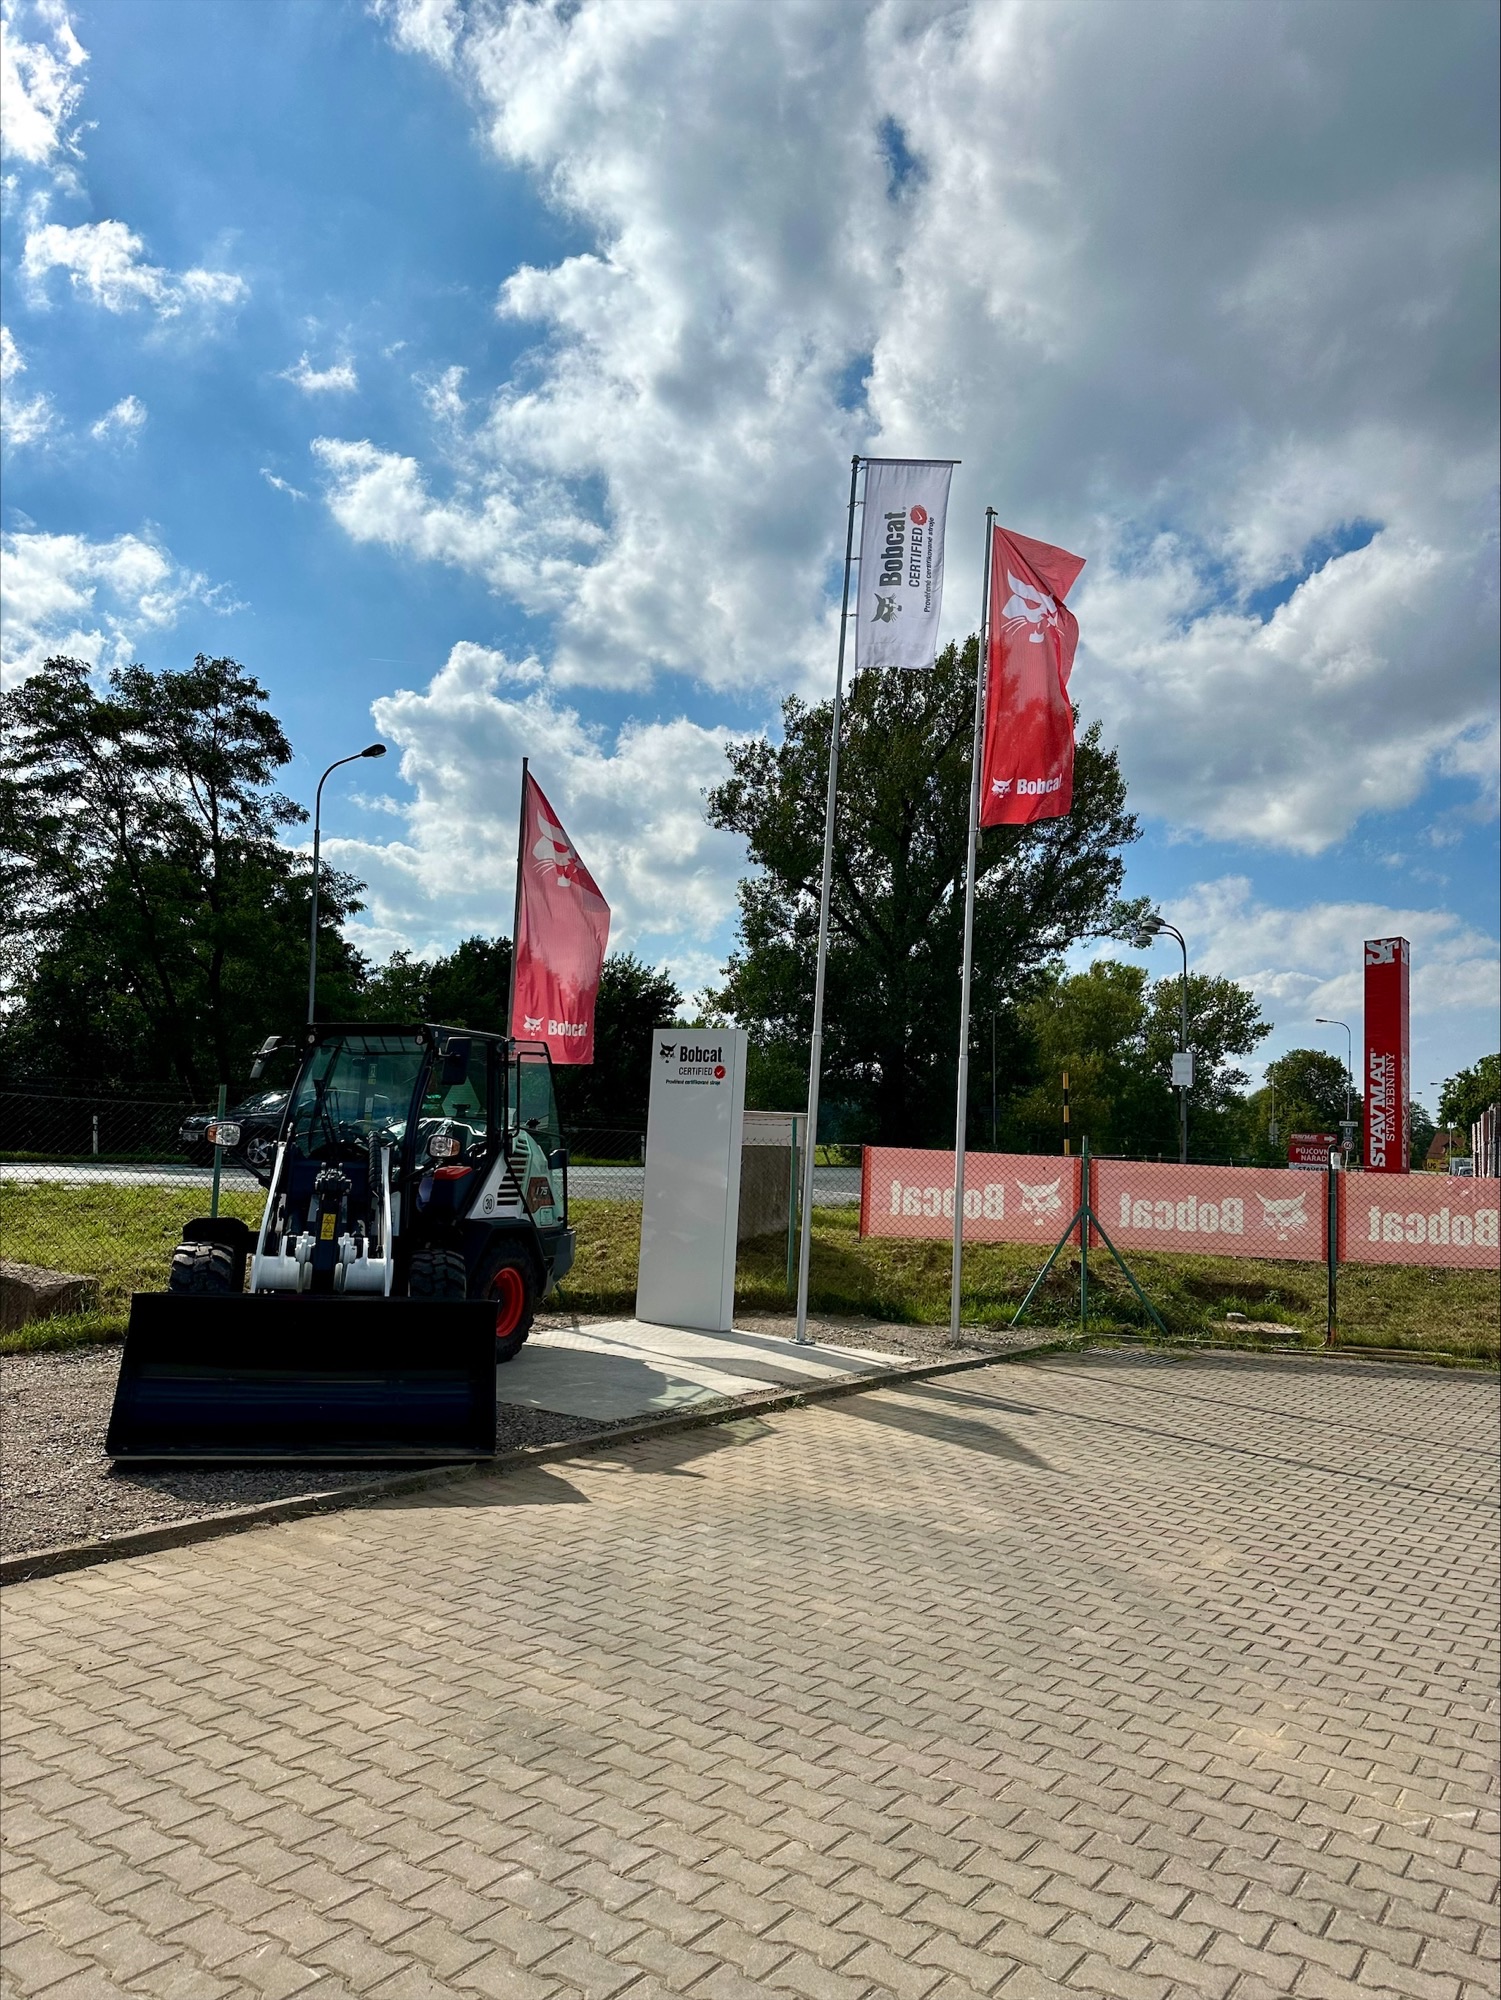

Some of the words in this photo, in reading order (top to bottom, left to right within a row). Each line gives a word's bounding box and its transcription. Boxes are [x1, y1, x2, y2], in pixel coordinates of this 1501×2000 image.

[879, 511, 906, 587] Bobcat
[908, 527, 923, 588] CERTIFIED
[547, 1019, 588, 1037] Bobcat
[680, 1045, 722, 1063] Bobcat
[678, 1066, 713, 1076] CERTIFIED
[1386, 1052, 1395, 1142] STAVEBNINY
[1370, 1052, 1386, 1168] STAVMAT
[1295, 1146, 1329, 1155] PŮJČOVN
[1301, 1154, 1328, 1162] NÁŘAD
[485, 1198, 493, 1210] 30
